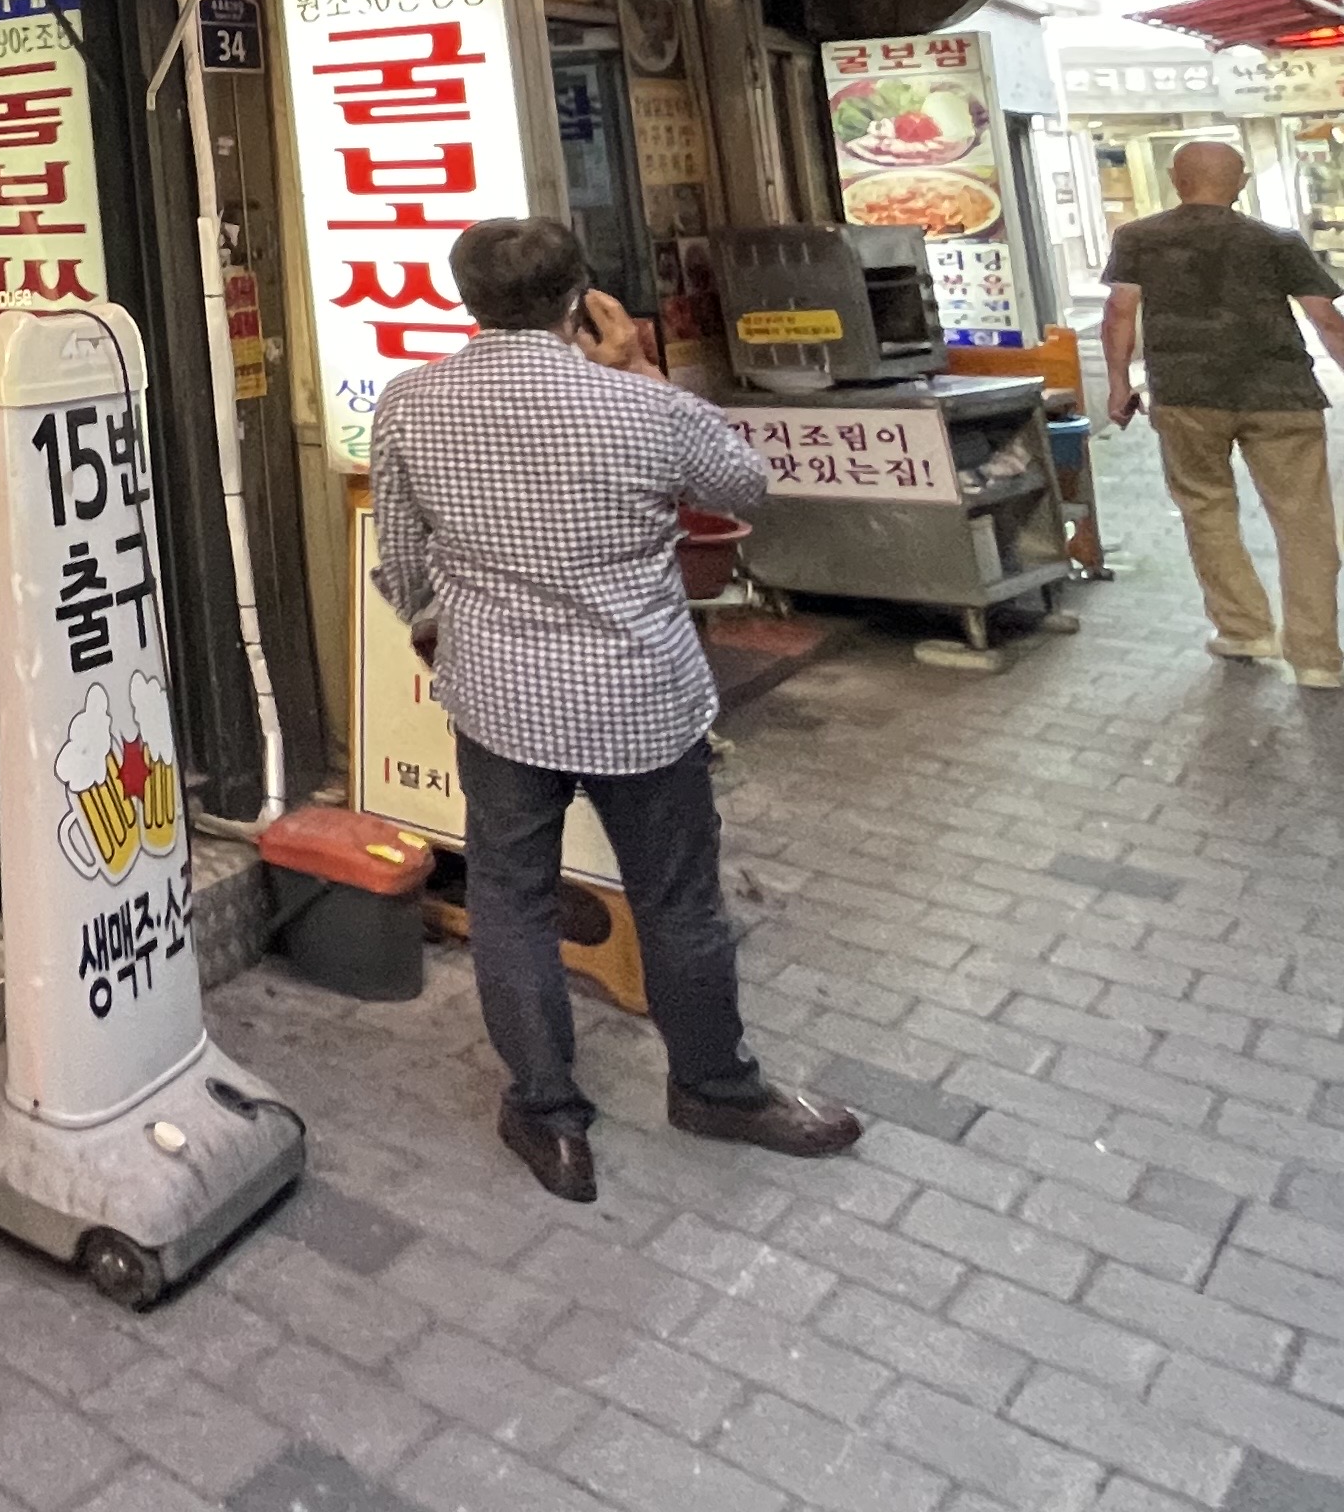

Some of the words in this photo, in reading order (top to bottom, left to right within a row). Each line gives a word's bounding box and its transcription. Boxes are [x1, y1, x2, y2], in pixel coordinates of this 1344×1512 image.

[217, 29, 246, 63] 34
[831, 38, 972, 74] 굴보쌈
[32, 403, 150, 528] 15번
[55, 533, 156, 674] 출구
